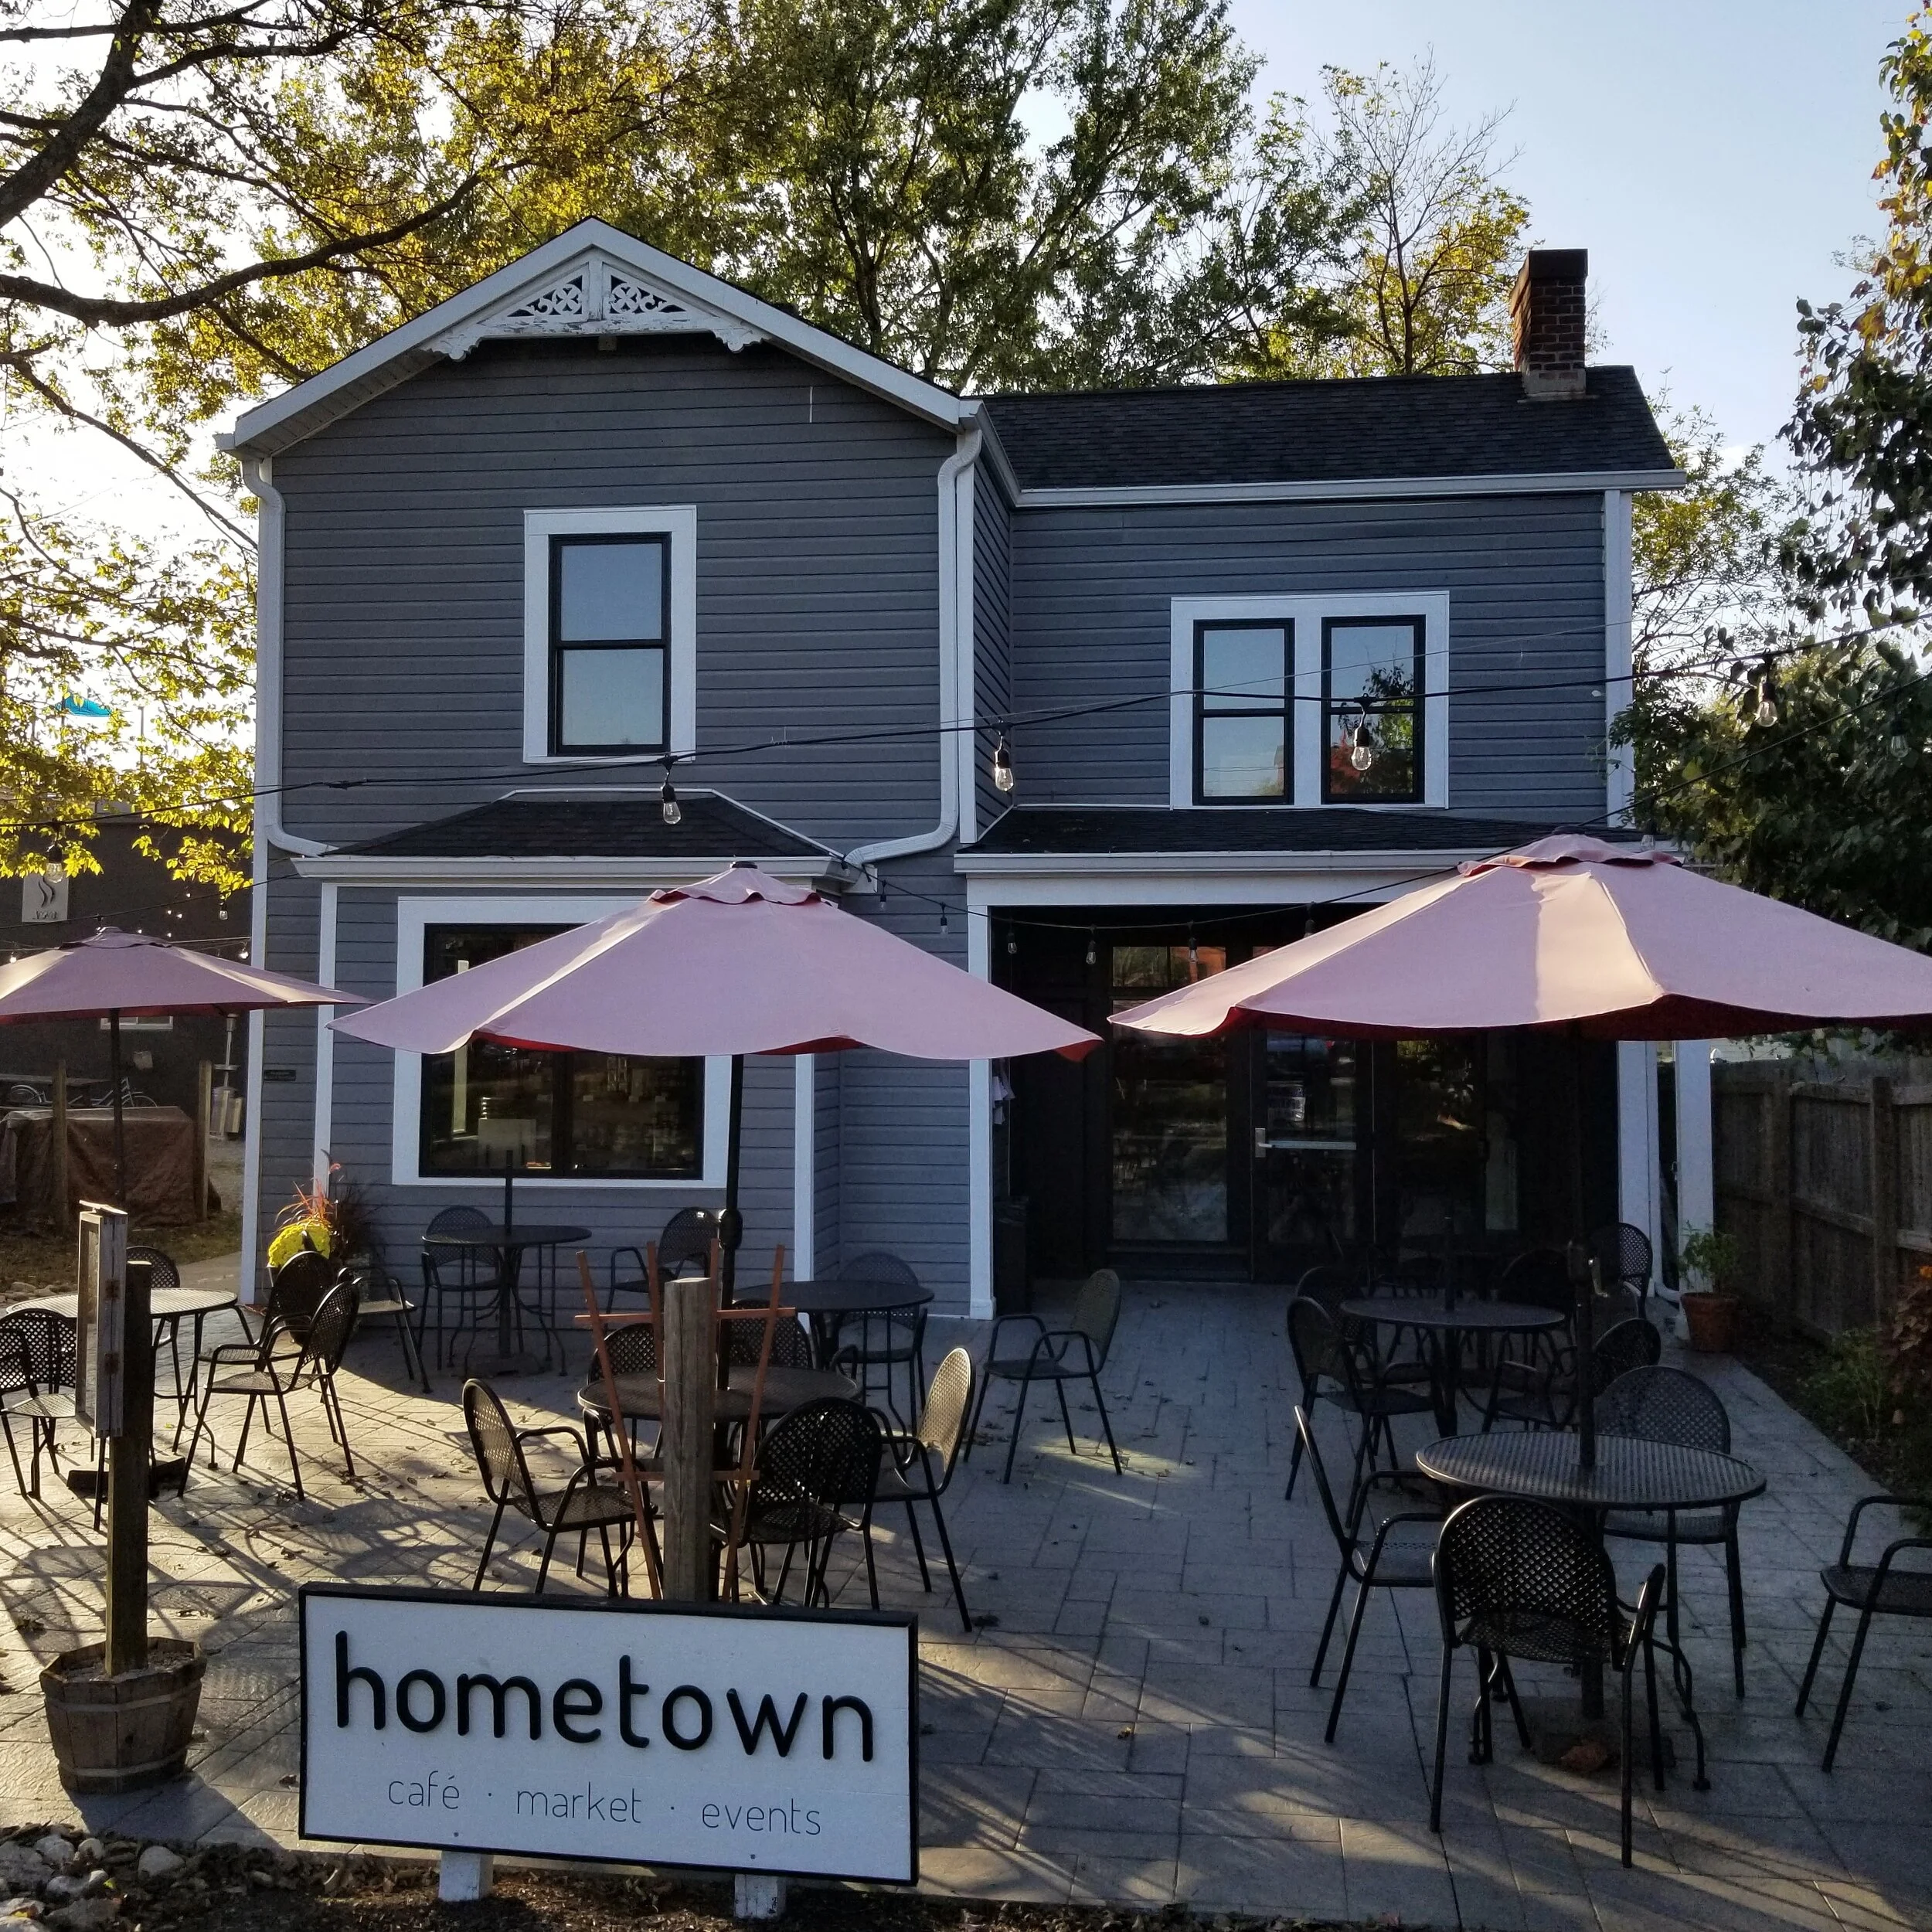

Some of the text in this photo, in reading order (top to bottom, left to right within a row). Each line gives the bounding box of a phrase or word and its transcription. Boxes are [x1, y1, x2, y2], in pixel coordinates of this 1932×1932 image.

[335, 1630, 873, 1762] hometown
[388, 1770, 821, 1835] café market events
